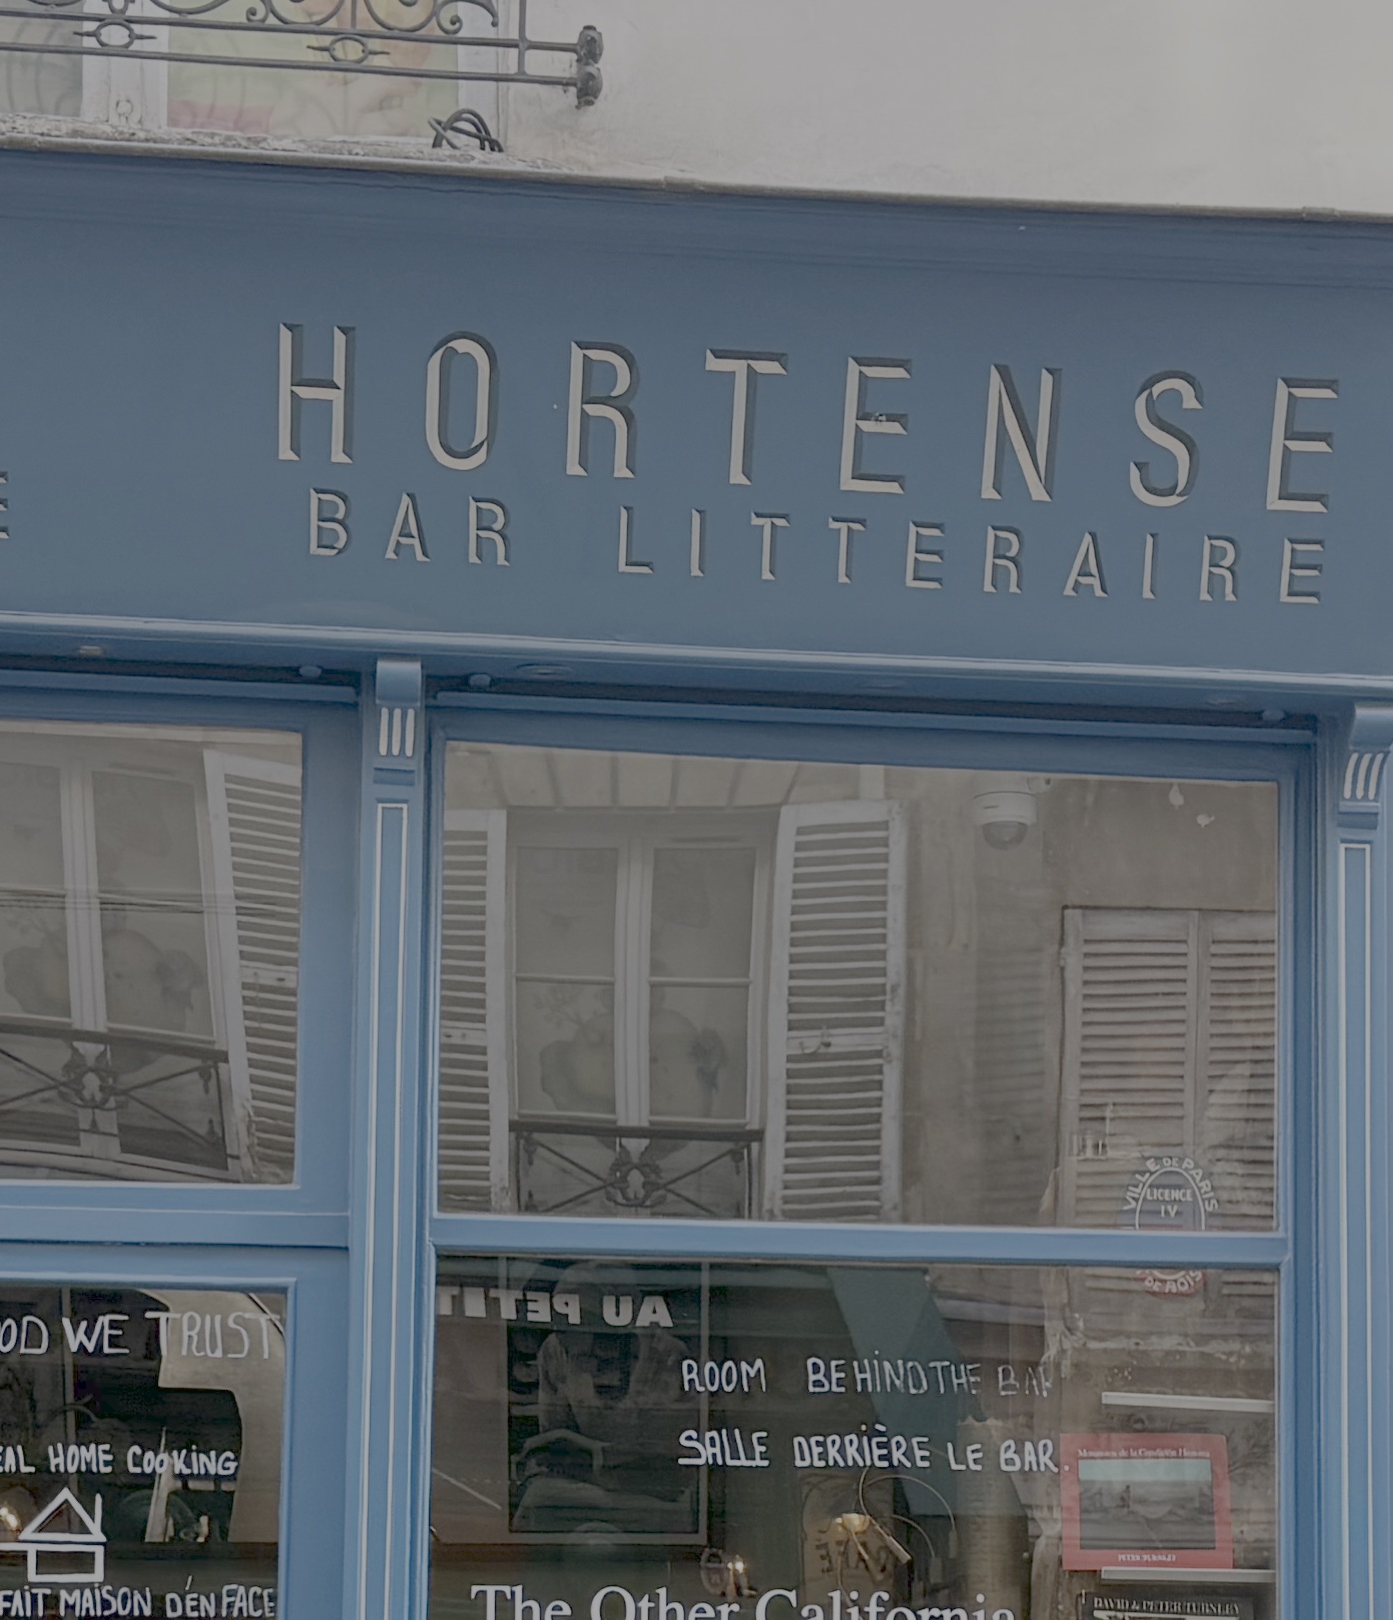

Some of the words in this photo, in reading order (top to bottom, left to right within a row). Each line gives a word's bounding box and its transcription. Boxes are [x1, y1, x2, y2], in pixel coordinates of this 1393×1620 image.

[279, 322, 1341, 515] HORTENSE
[308, 487, 511, 566] BAR
[618, 505, 1326, 603] LITTERAIRE
[1122, 1157, 1161, 1211] VILLE
[1162, 1157, 1180, 1167] DE
[1181, 1157, 1219, 1212] PARIS
[1146, 1188, 1194, 1202] LICENCE
[1160, 1204, 1179, 1218] IV
[62, 1314, 130, 1354] WE
[145, 1311, 280, 1359] TRUST
[682, 1358, 767, 1394] ROOM
[49, 1442, 114, 1474] HOME
[677, 1427, 770, 1468] SALLE
[947, 1441, 983, 1473] LE
[221, 1583, 276, 1618] FACE
